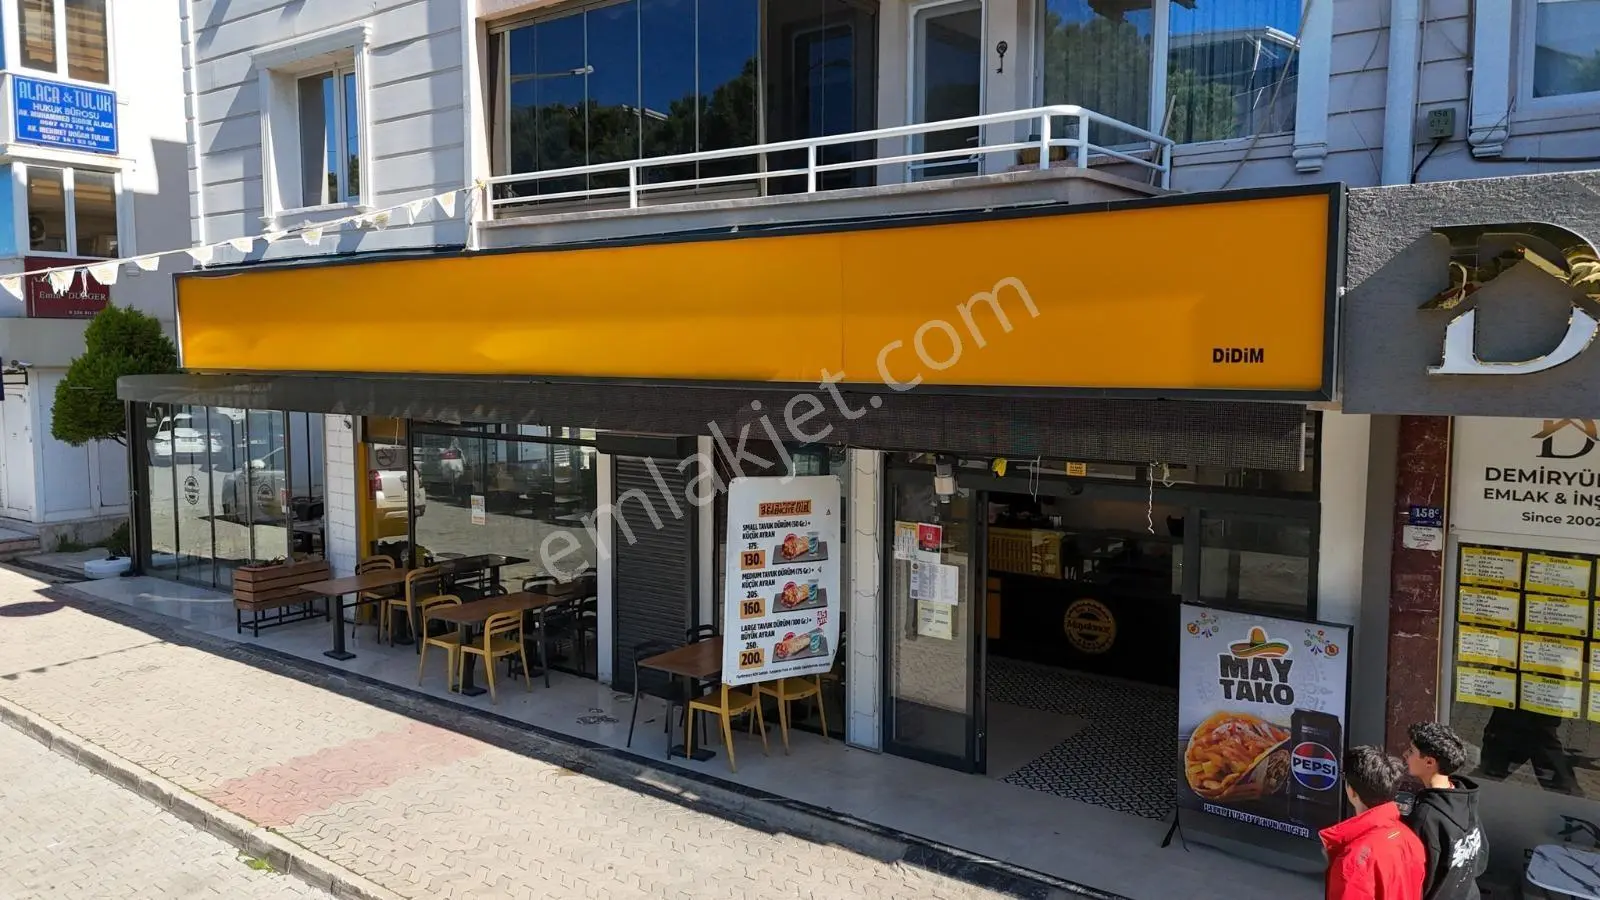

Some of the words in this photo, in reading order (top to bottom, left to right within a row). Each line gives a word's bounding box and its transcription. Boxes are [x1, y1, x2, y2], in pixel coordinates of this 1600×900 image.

[19, 81, 60, 103] ALACA
[63, 92, 73, 104] &
[74, 90, 111, 113] TULUK
[33, 103, 63, 114] HUKUK
[65, 107, 100, 120] BÜROSU
[91, 133, 111, 142] TULUK
[1485, 466, 1600, 488] DEMİRYÜ
[1484, 487, 1549, 504] EMLAK
[1555, 492, 1567, 504] &
[742, 522, 758, 531] SMALL
[758, 521, 774, 530] TAVUK
[774, 519, 791, 529] DÜRÜM
[1522, 511, 1562, 524] Since
[1566, 514, 1600, 527] 2002
[742, 530, 758, 540] KÜÇÜK
[759, 531, 775, 539] AYRAN
[761, 570, 777, 579] TAVUK
[778, 568, 795, 577] DÜRÜM
[741, 579, 758, 589] KÜÇÜK
[758, 579, 775, 588] AYRAN
[741, 622, 758, 632] LARGE
[758, 621, 773, 630] TAVUK
[758, 630, 775, 638] AYRAN
[1219, 653, 1293, 684] MAY
[1219, 678, 1295, 706] TAKO
[1292, 757, 1336, 776] PEPSI
